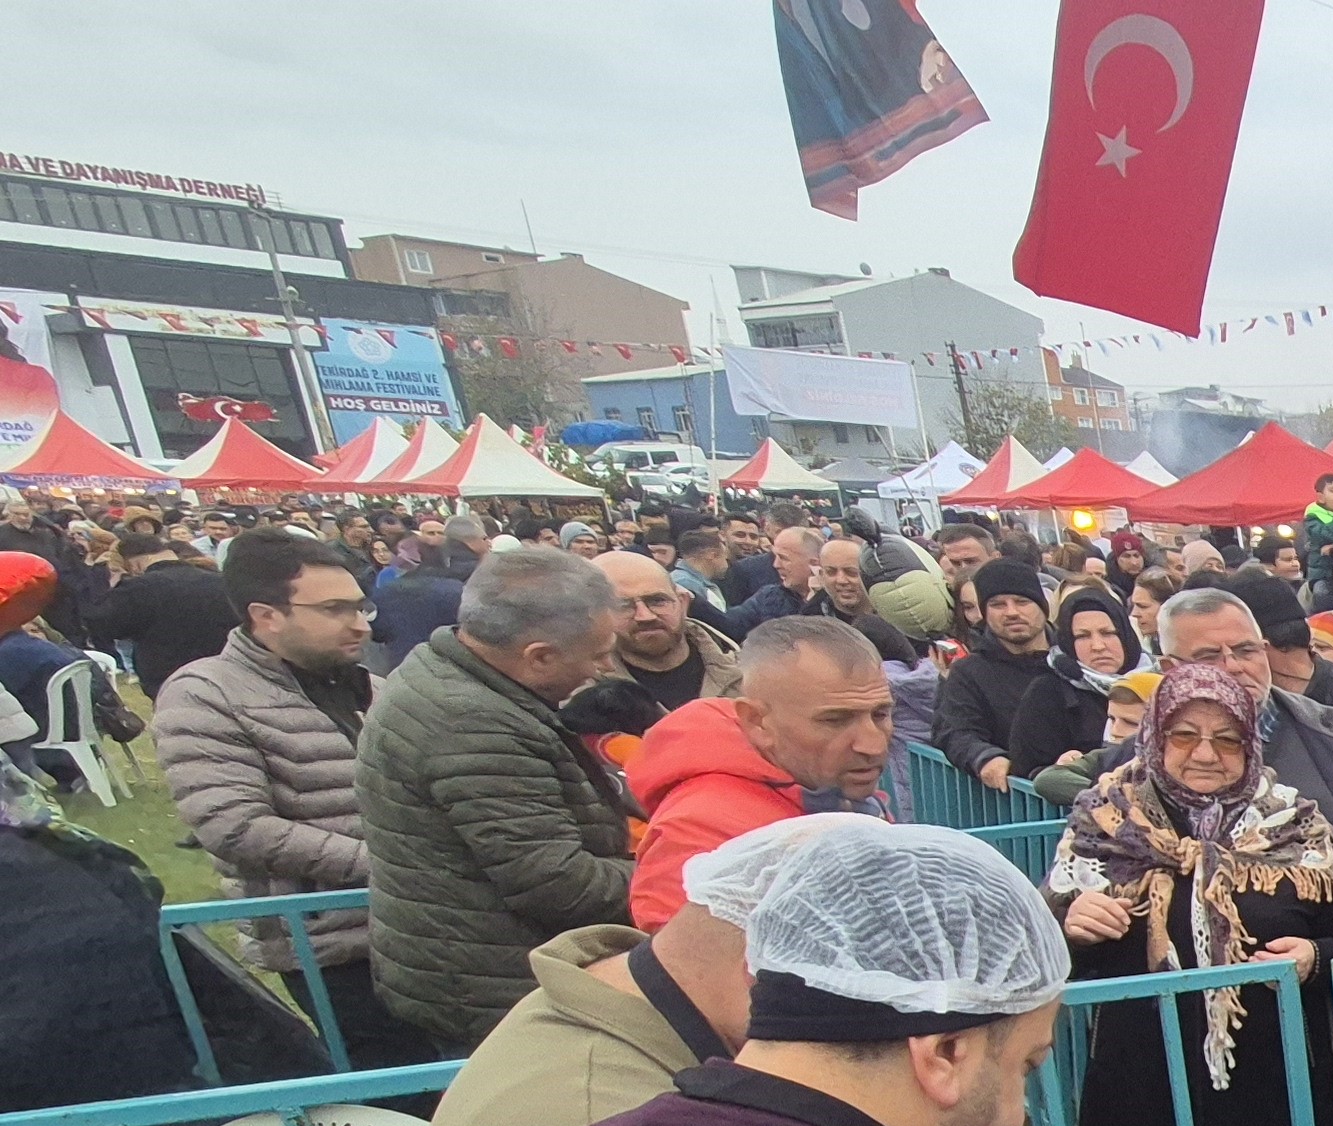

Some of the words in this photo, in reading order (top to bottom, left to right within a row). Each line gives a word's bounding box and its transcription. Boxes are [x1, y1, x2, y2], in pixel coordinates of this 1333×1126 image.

[24, 155, 58, 176] VE
[58, 160, 179, 190] DAYANIŞMA
[179, 177, 266, 204] DERNEĞİ
[424, 373, 439, 384] VE
[330, 396, 366, 412] HOŞ
[369, 399, 442, 414] GELDİNİZ
